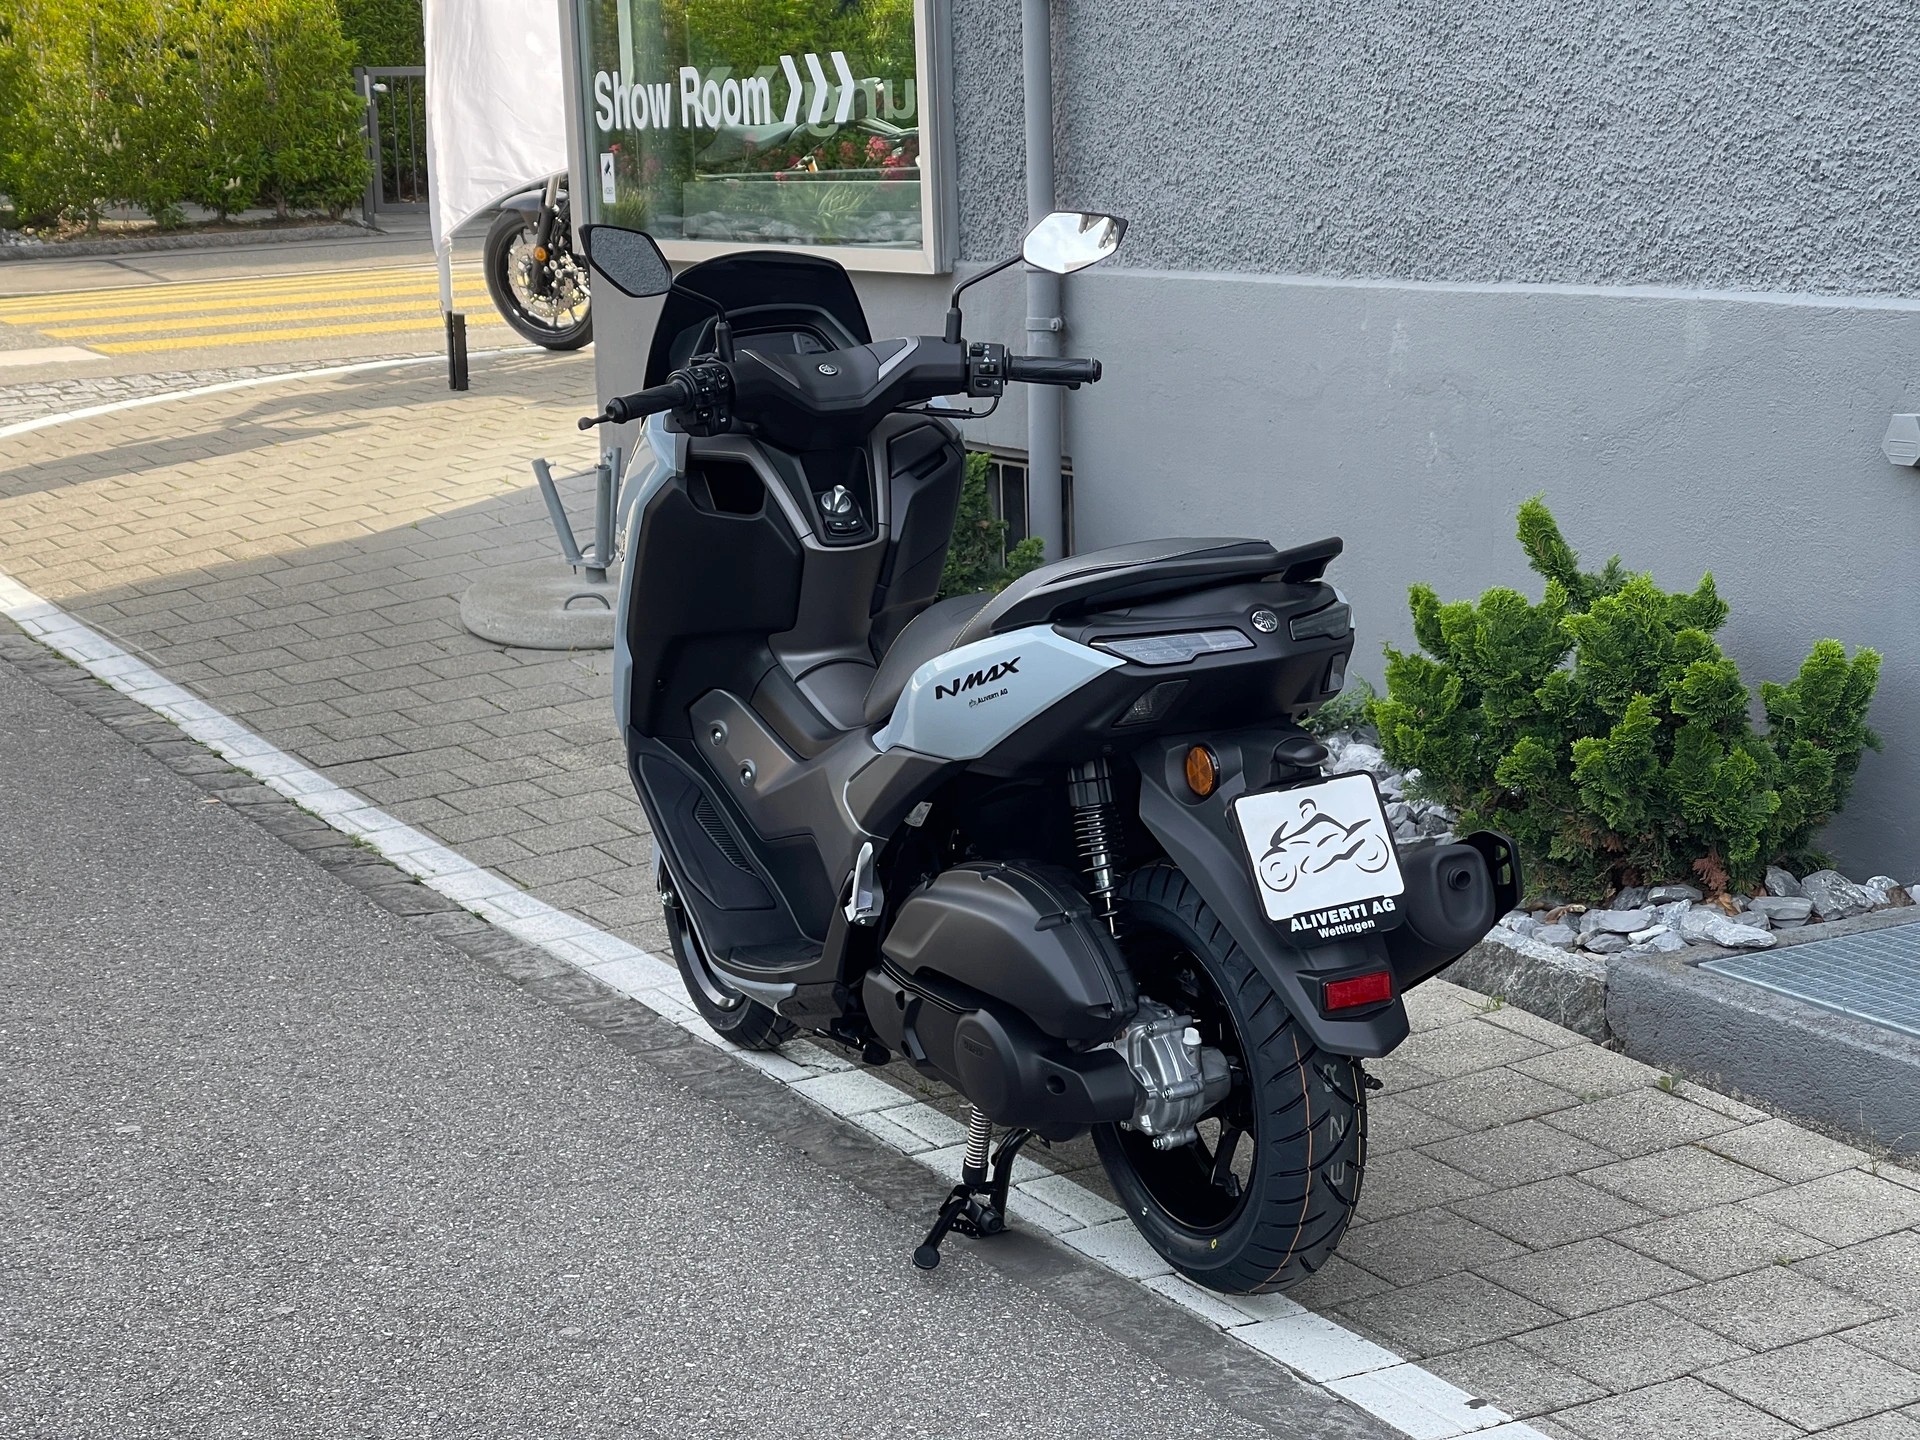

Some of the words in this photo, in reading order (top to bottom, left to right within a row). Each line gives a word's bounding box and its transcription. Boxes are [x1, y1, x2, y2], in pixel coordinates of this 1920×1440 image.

[594, 70, 671, 131] Show
[679, 66, 770, 128] Room
[935, 656, 1021, 700] NMAX
[1290, 903, 1368, 932] ALIVERTI
[1372, 898, 1396, 915] AG
[1317, 919, 1376, 939] Wettingen
